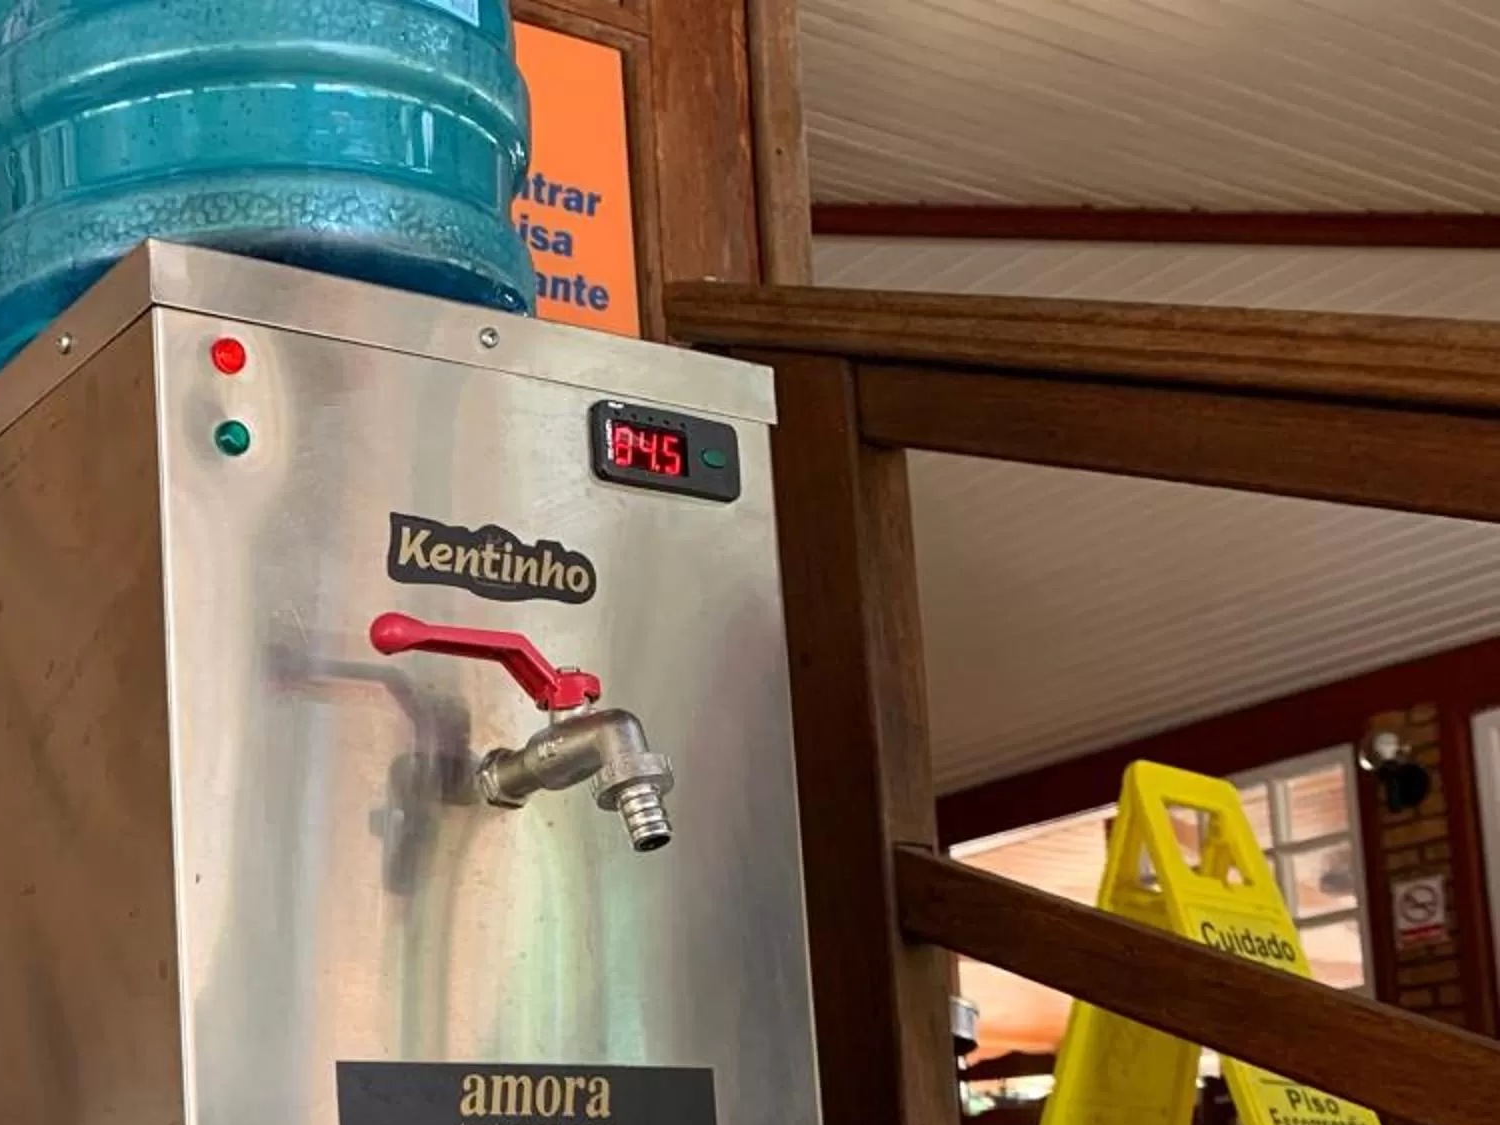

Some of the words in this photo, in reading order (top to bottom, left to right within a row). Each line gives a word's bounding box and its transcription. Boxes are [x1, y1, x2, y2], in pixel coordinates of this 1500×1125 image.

[398, 526, 591, 594] Kentinho
[1201, 922, 1296, 962] Cuidado
[460, 1072, 612, 1119] amora
